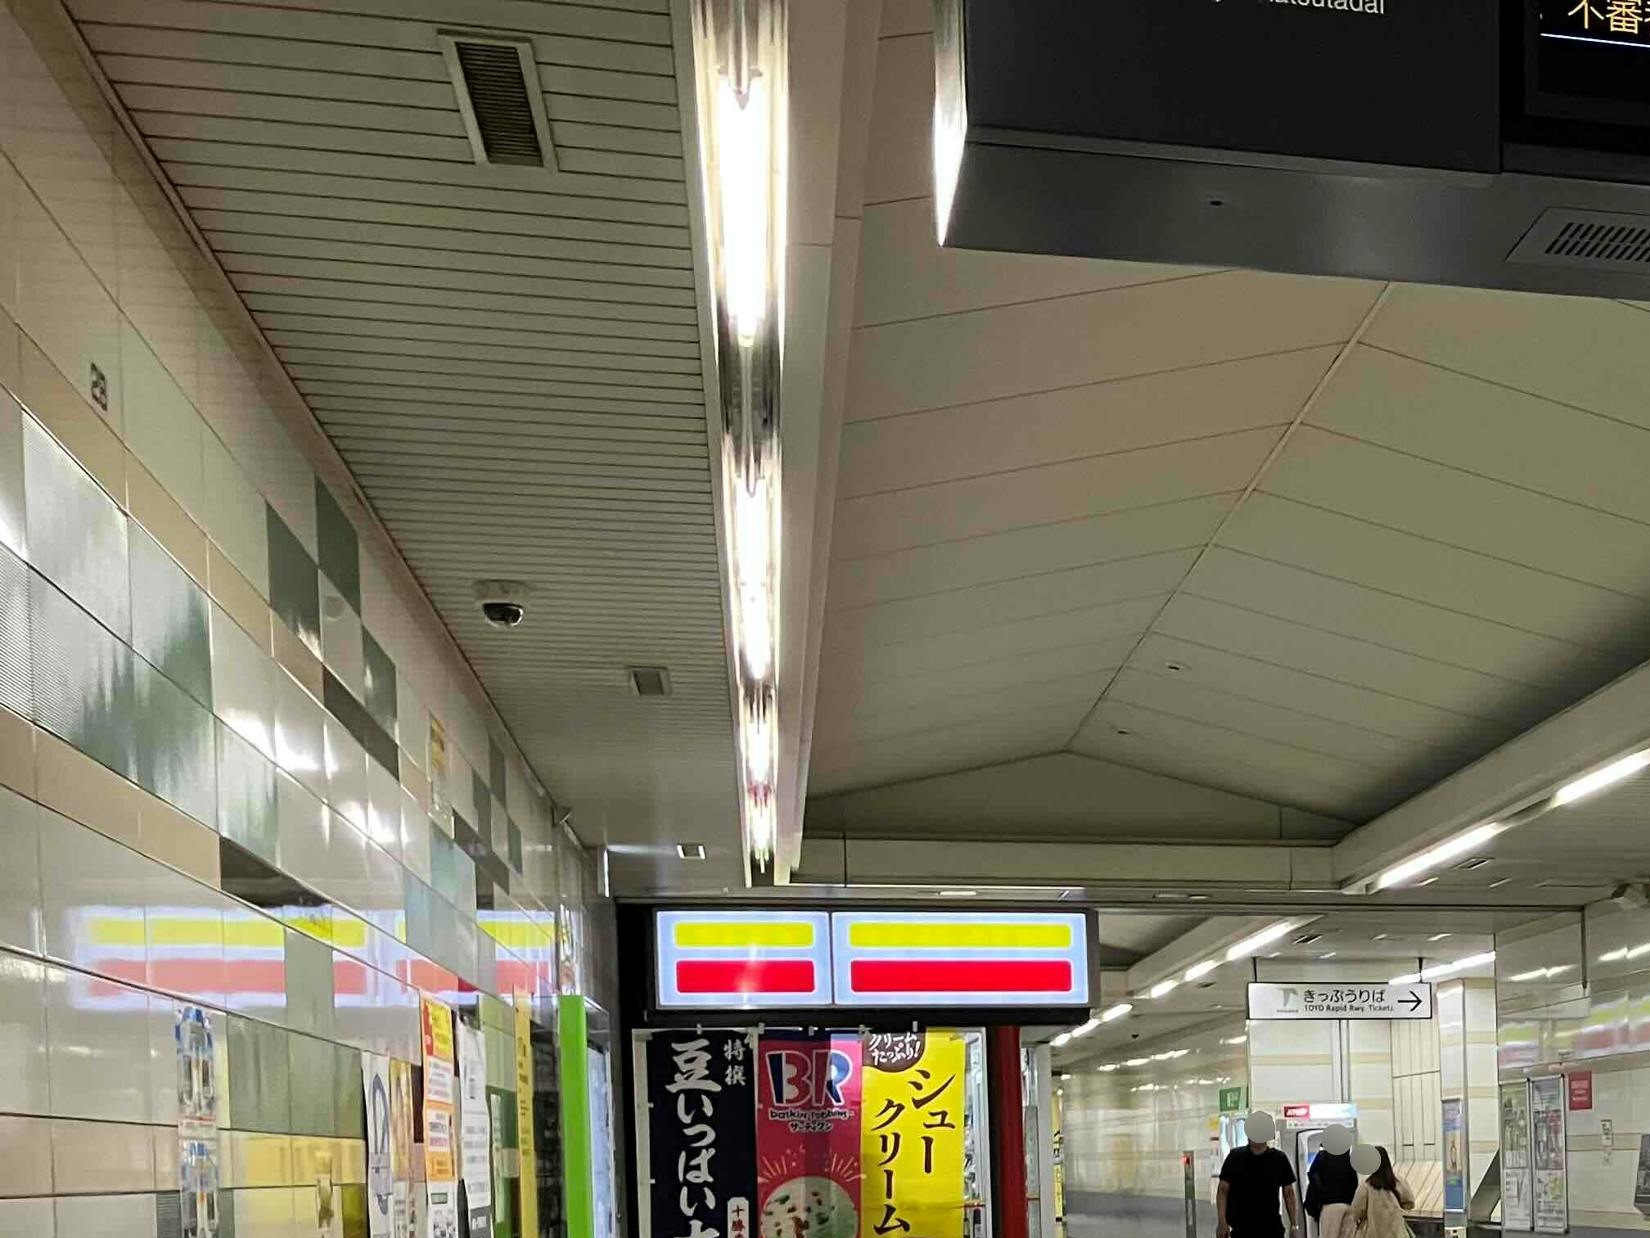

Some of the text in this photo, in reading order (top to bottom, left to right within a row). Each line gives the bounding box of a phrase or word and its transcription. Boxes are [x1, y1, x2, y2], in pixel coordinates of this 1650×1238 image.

[1304, 989, 1386, 1004] きっぷうりば
[870, 1033, 918, 1051] クリーム
[766, 1050, 853, 1107] BR
[908, 1068, 957, 1175] シュー
[870, 1098, 913, 1236] クリーム
